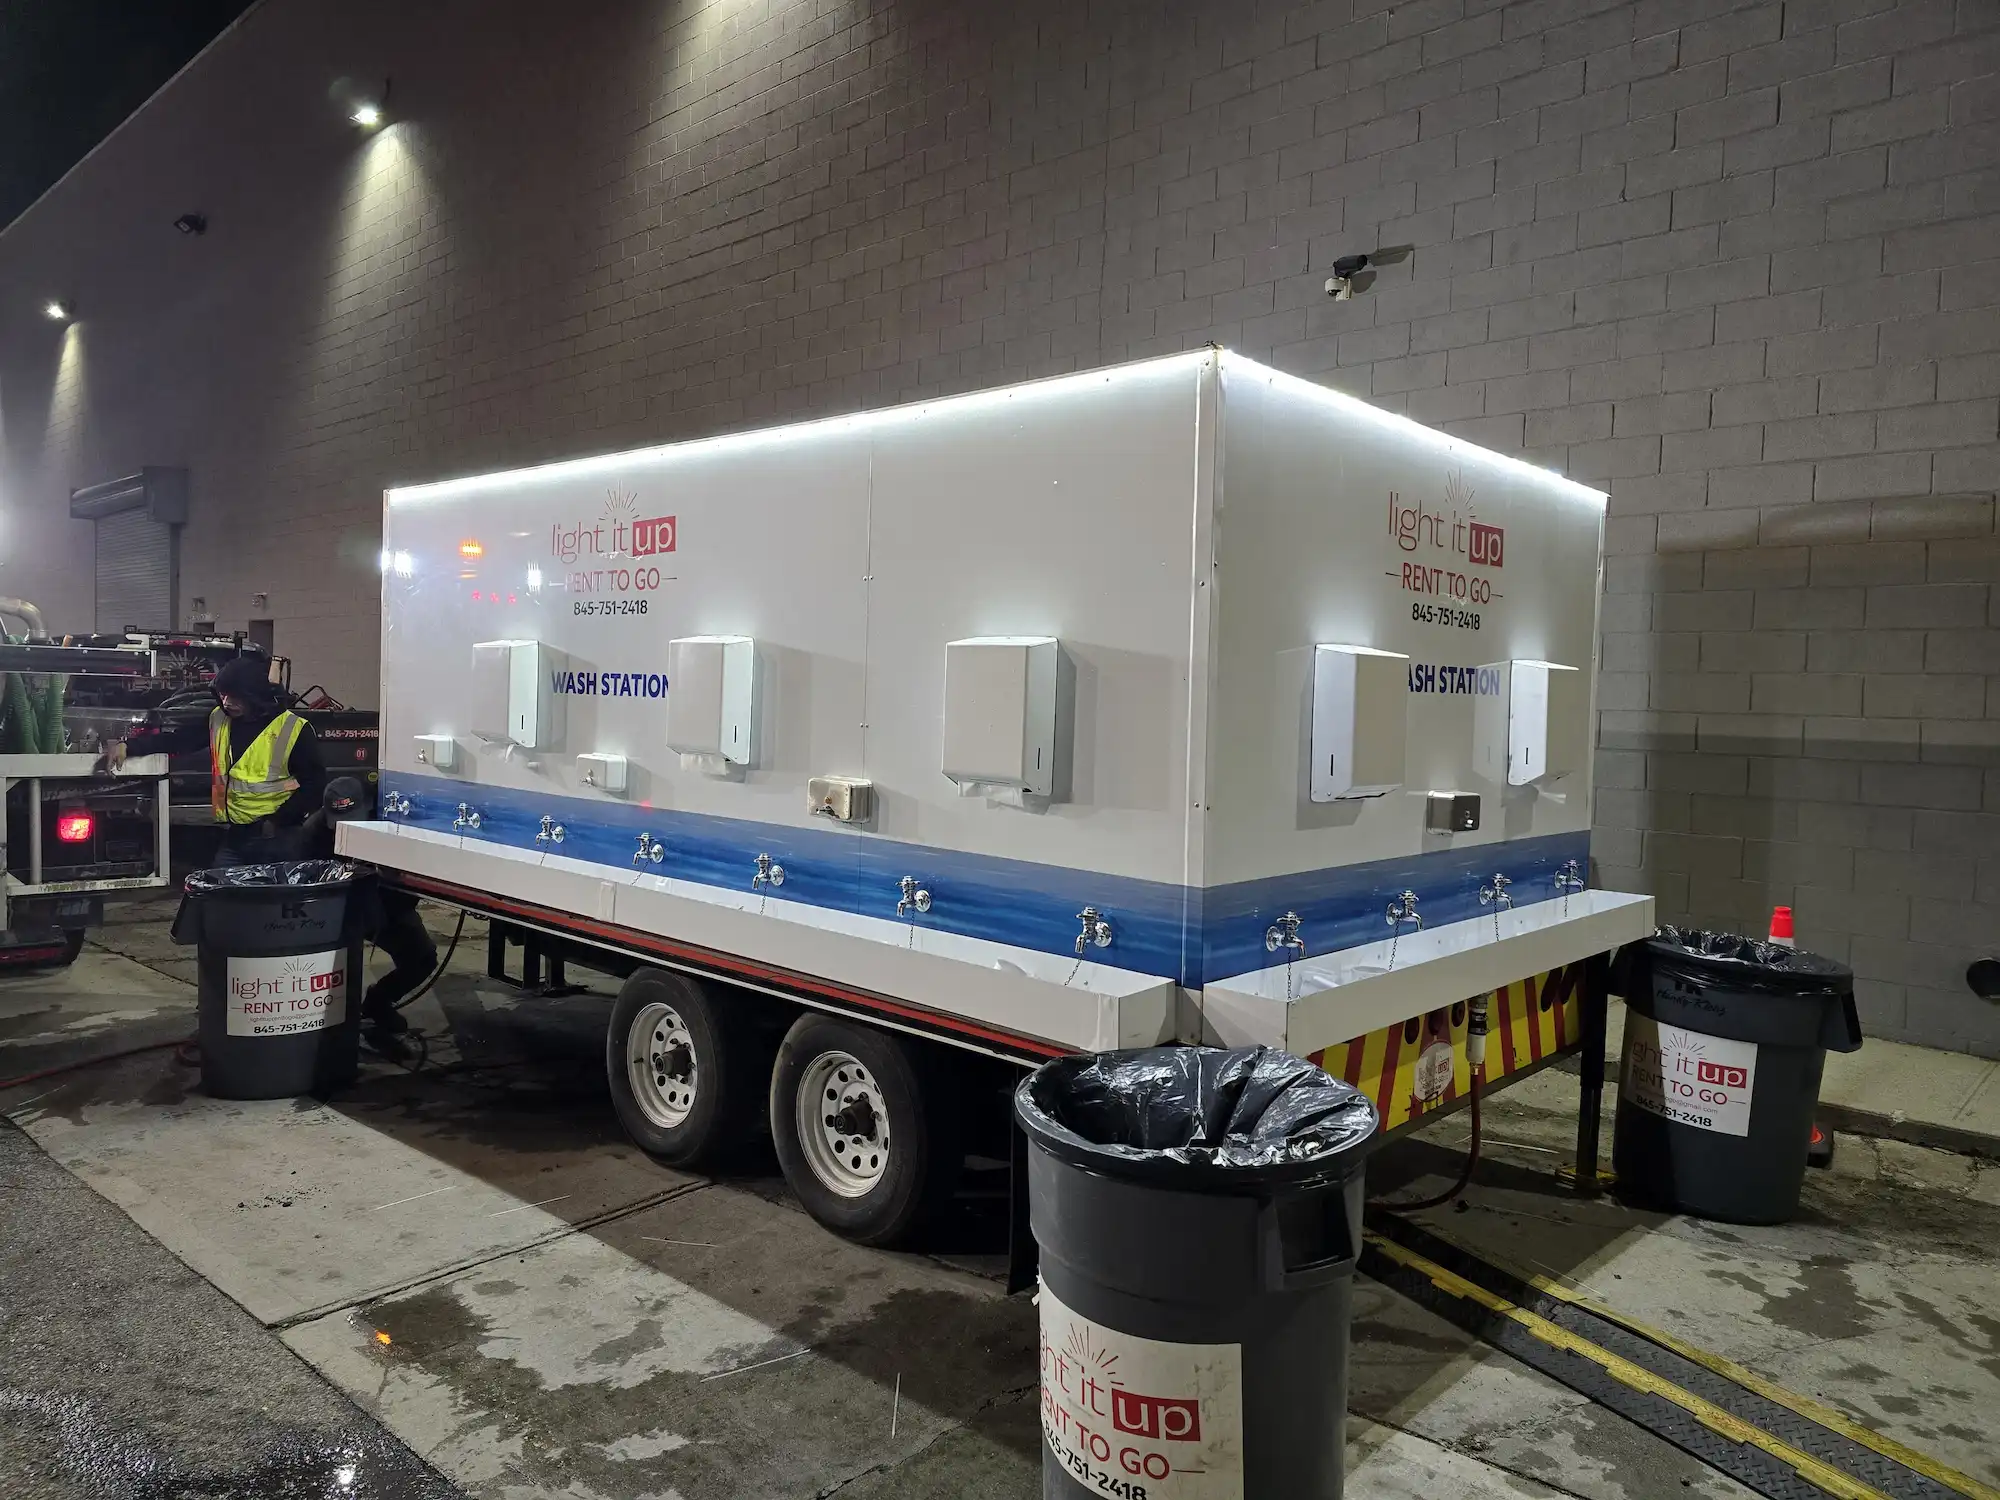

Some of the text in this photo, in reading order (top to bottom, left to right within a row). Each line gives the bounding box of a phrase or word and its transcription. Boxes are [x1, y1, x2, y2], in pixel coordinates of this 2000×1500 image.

[552, 518, 673, 564] light it up
[1388, 491, 1502, 567] light it up
[608, 569, 630, 591] TO
[634, 567, 660, 590] GO
[1402, 562, 1491, 604] RENT TO GO
[573, 600, 648, 616] 845-751-2418
[1412, 602, 1481, 630] 845-751-2418
[551, 670, 597, 695] WASH
[1439, 665, 1500, 696] STATION
[325, 730, 379, 738] 845-751-2418
[356, 749, 365, 758] 01
[232, 972, 342, 999] light it up
[244, 994, 334, 1014] RENT TO GO
[253, 1018, 325, 1034] 845-751-2418
[1632, 1039, 1744, 1088] ght it up
[1632, 1064, 1667, 1090] RENT
[1669, 1079, 1694, 1098] TO
[1699, 1088, 1728, 1105] GO
[1636, 1094, 1713, 1127] 845-751-2418
[1081, 1365, 1105, 1417] it
[1117, 1397, 1193, 1440] up
[1075, 1421, 1111, 1462] TO
[1119, 1447, 1170, 1480] GO
